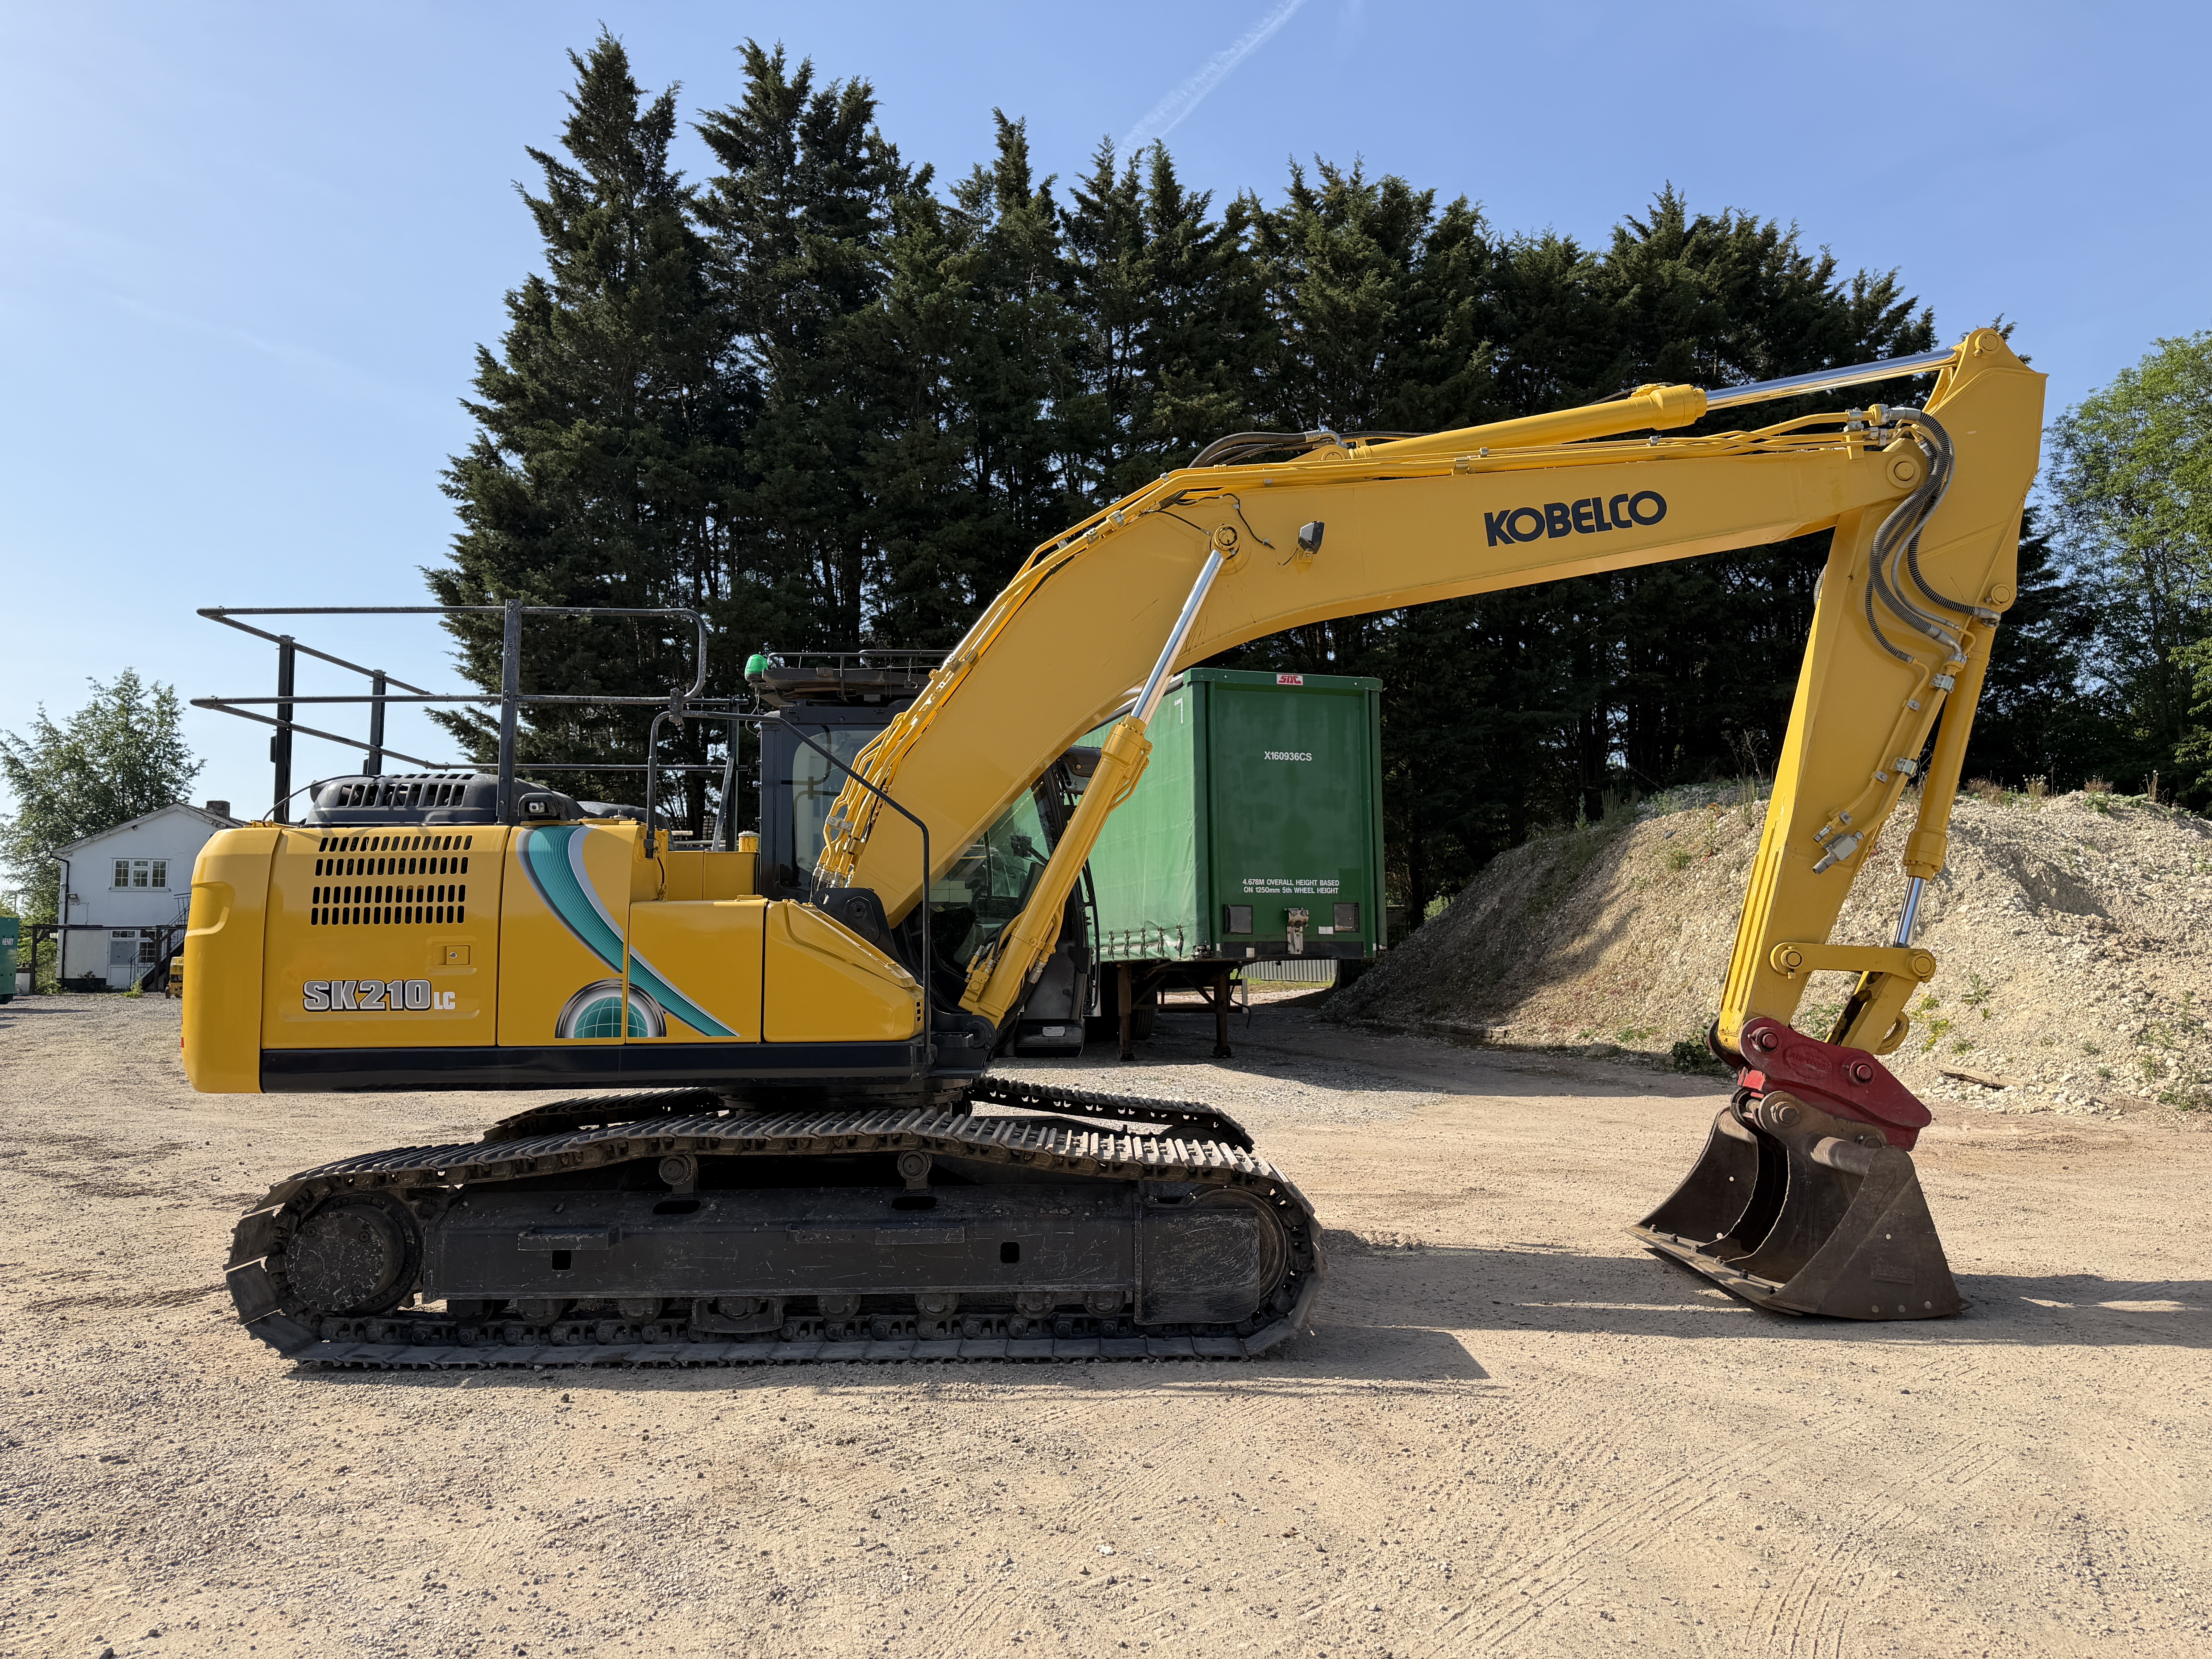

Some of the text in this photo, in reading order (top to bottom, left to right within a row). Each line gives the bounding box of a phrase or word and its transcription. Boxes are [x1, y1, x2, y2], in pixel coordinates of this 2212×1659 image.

[1484, 490, 1667, 547] KOBELCO
[1278, 675, 1302, 684] SDC
[1264, 751, 1312, 761] X160936CS
[303, 979, 455, 1012] SK210 LC
